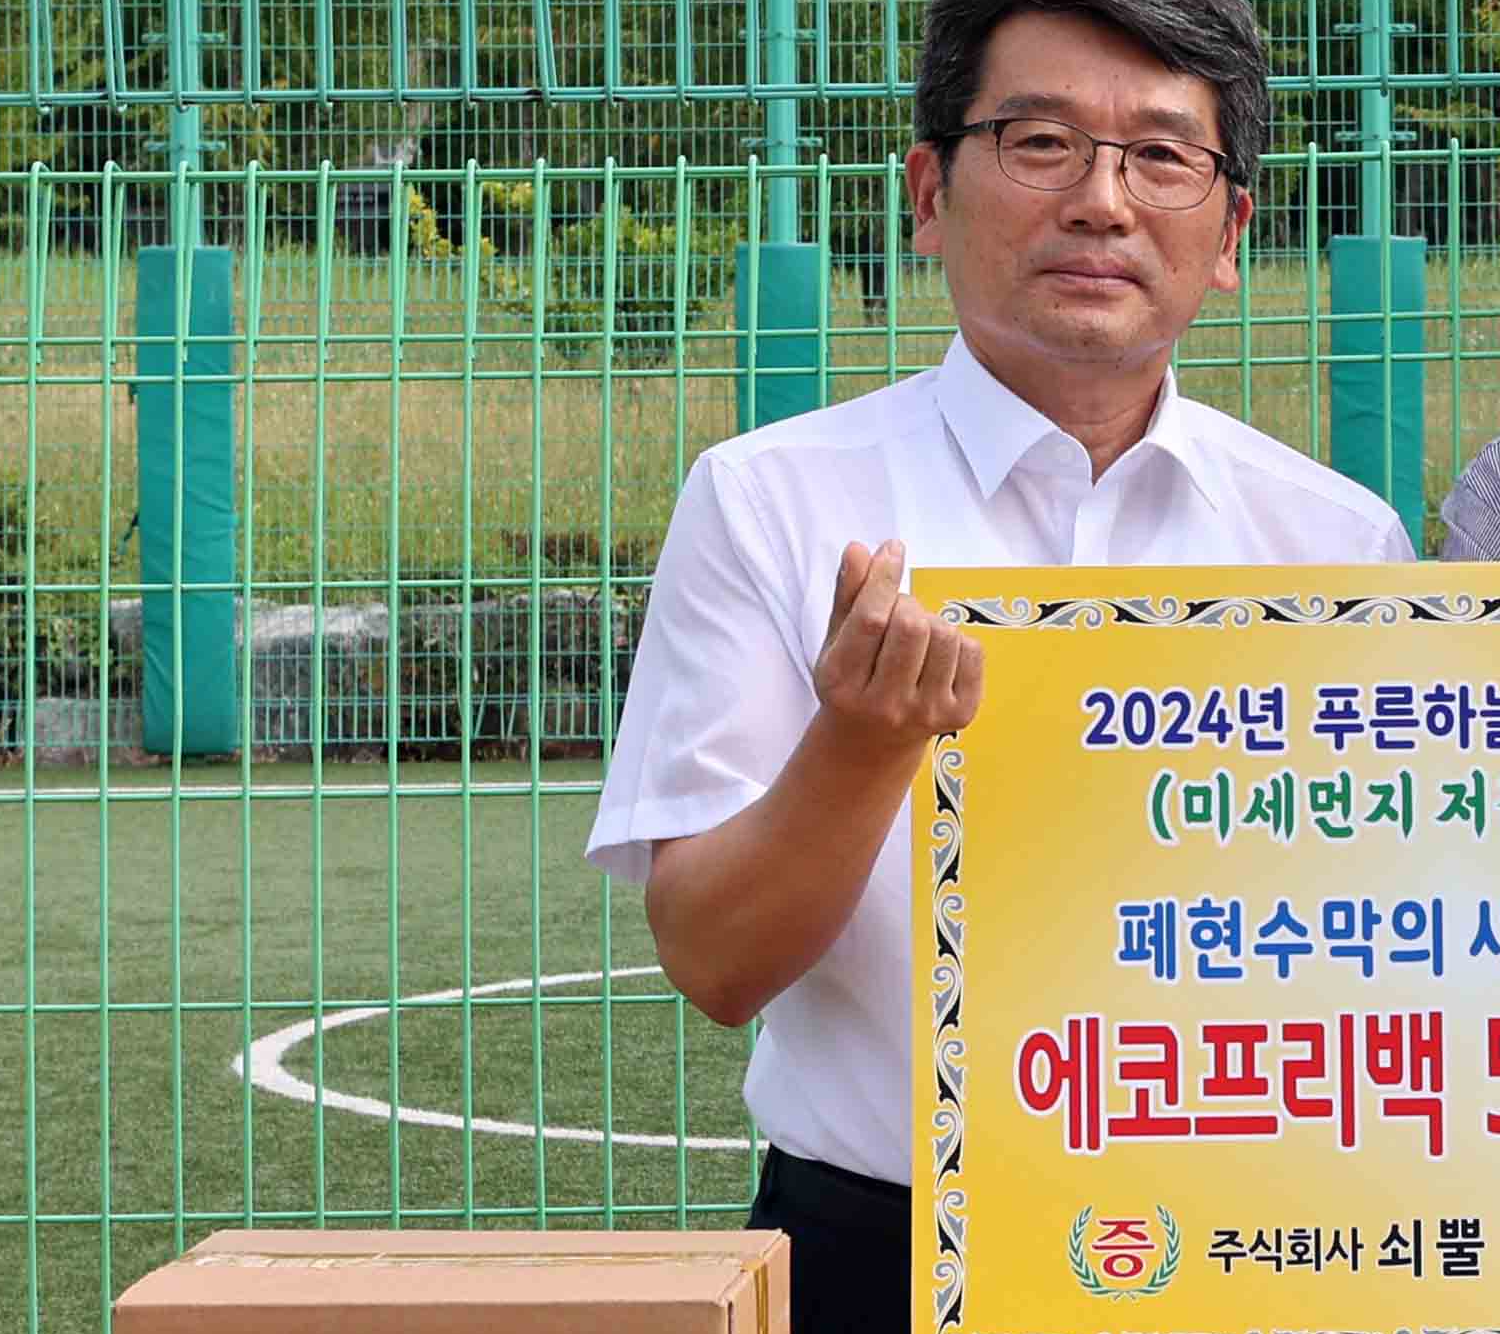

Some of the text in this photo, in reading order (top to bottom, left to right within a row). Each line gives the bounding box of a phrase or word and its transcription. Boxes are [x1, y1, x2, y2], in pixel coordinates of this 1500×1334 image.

[1087, 688, 1284, 750] 2024년
[1155, 773, 1412, 837] (미세먼지
[1120, 899, 1443, 979] 폐현수막의
[1020, 1012, 1443, 1156] 에코프리백
[1092, 1221, 1154, 1277] 증
[1209, 1228, 1364, 1272] 주식회사
